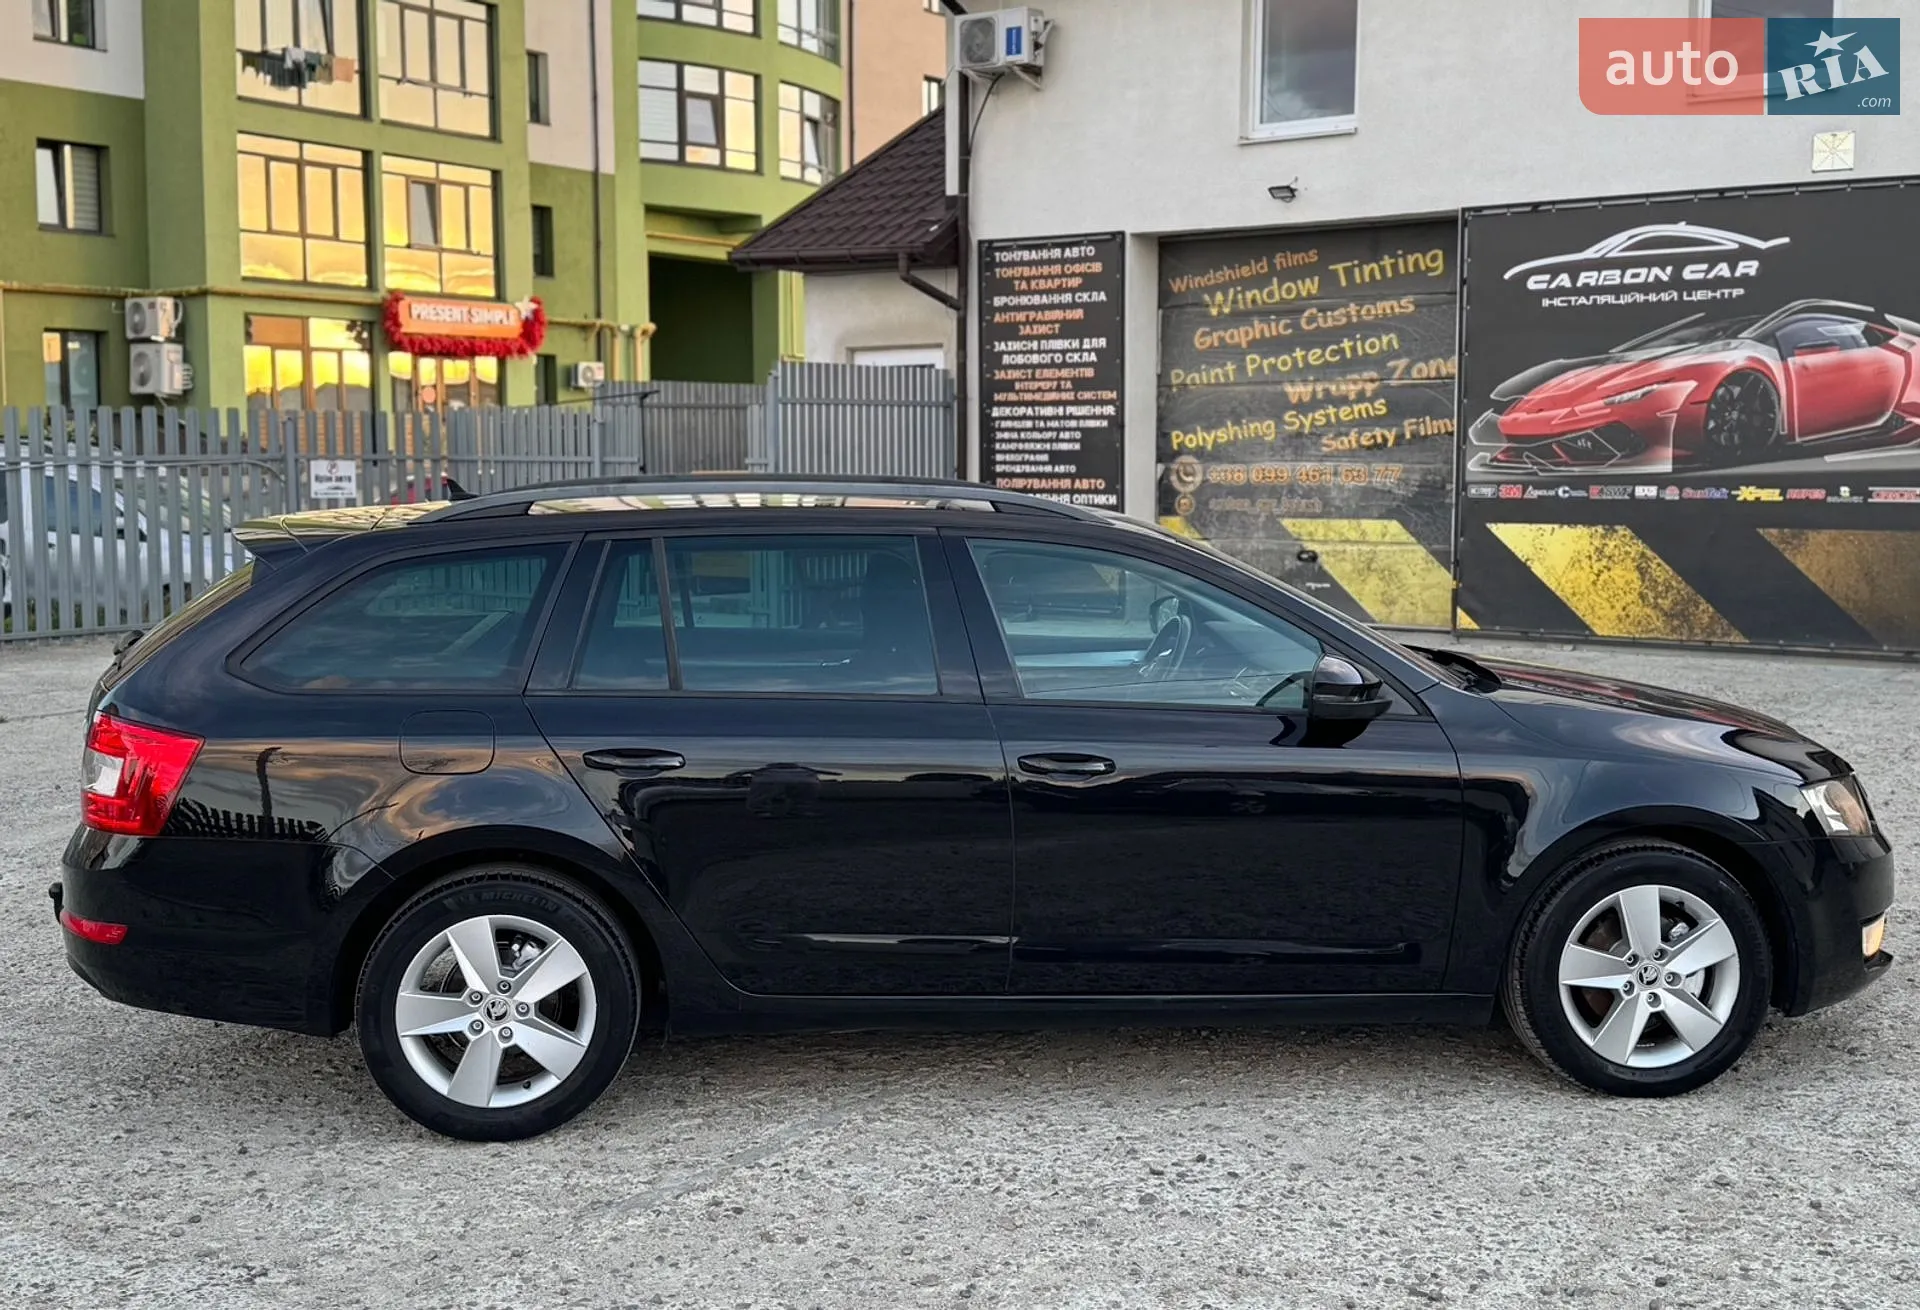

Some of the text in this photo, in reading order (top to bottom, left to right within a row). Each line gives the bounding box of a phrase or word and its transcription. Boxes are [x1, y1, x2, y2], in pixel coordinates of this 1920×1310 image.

[994, 246, 1095, 262] ТОНУВАННЯ АВТО
[994, 264, 1061, 278] ТОНУВАННЯ
[1169, 248, 1318, 293] Windshield films
[1526, 260, 1759, 290] CARBON CAR
[1013, 277, 1083, 291] ТА КВАРТИР
[1204, 248, 1444, 316] Window Tinting
[993, 291, 1107, 307] БРОНЮВАННЯ СКЛА
[1542, 288, 1745, 307] ІНСТАЛЯЦІЙНИЙ ЦЕНТР
[411, 303, 517, 326] PRESENT SIMPLE
[1019, 324, 1060, 336] ЗАХИСТ
[1194, 296, 1415, 350] Graphic Customs
[993, 337, 1107, 352] ЗАХИСНІ ПЛІВКИ ДЛЯ
[1002, 352, 1098, 365] ЛОБОВОГО СКЛА
[1170, 332, 1400, 392] Paint Protection
[993, 369, 1033, 380] ЗАХИСТ
[1059, 381, 1073, 390] ТА
[1171, 398, 1388, 451] Polyshing Systems
[1321, 427, 1397, 453] Safety
[1073, 477, 1106, 490] АВТО
[1071, 493, 1118, 505] ОПТИКИ
